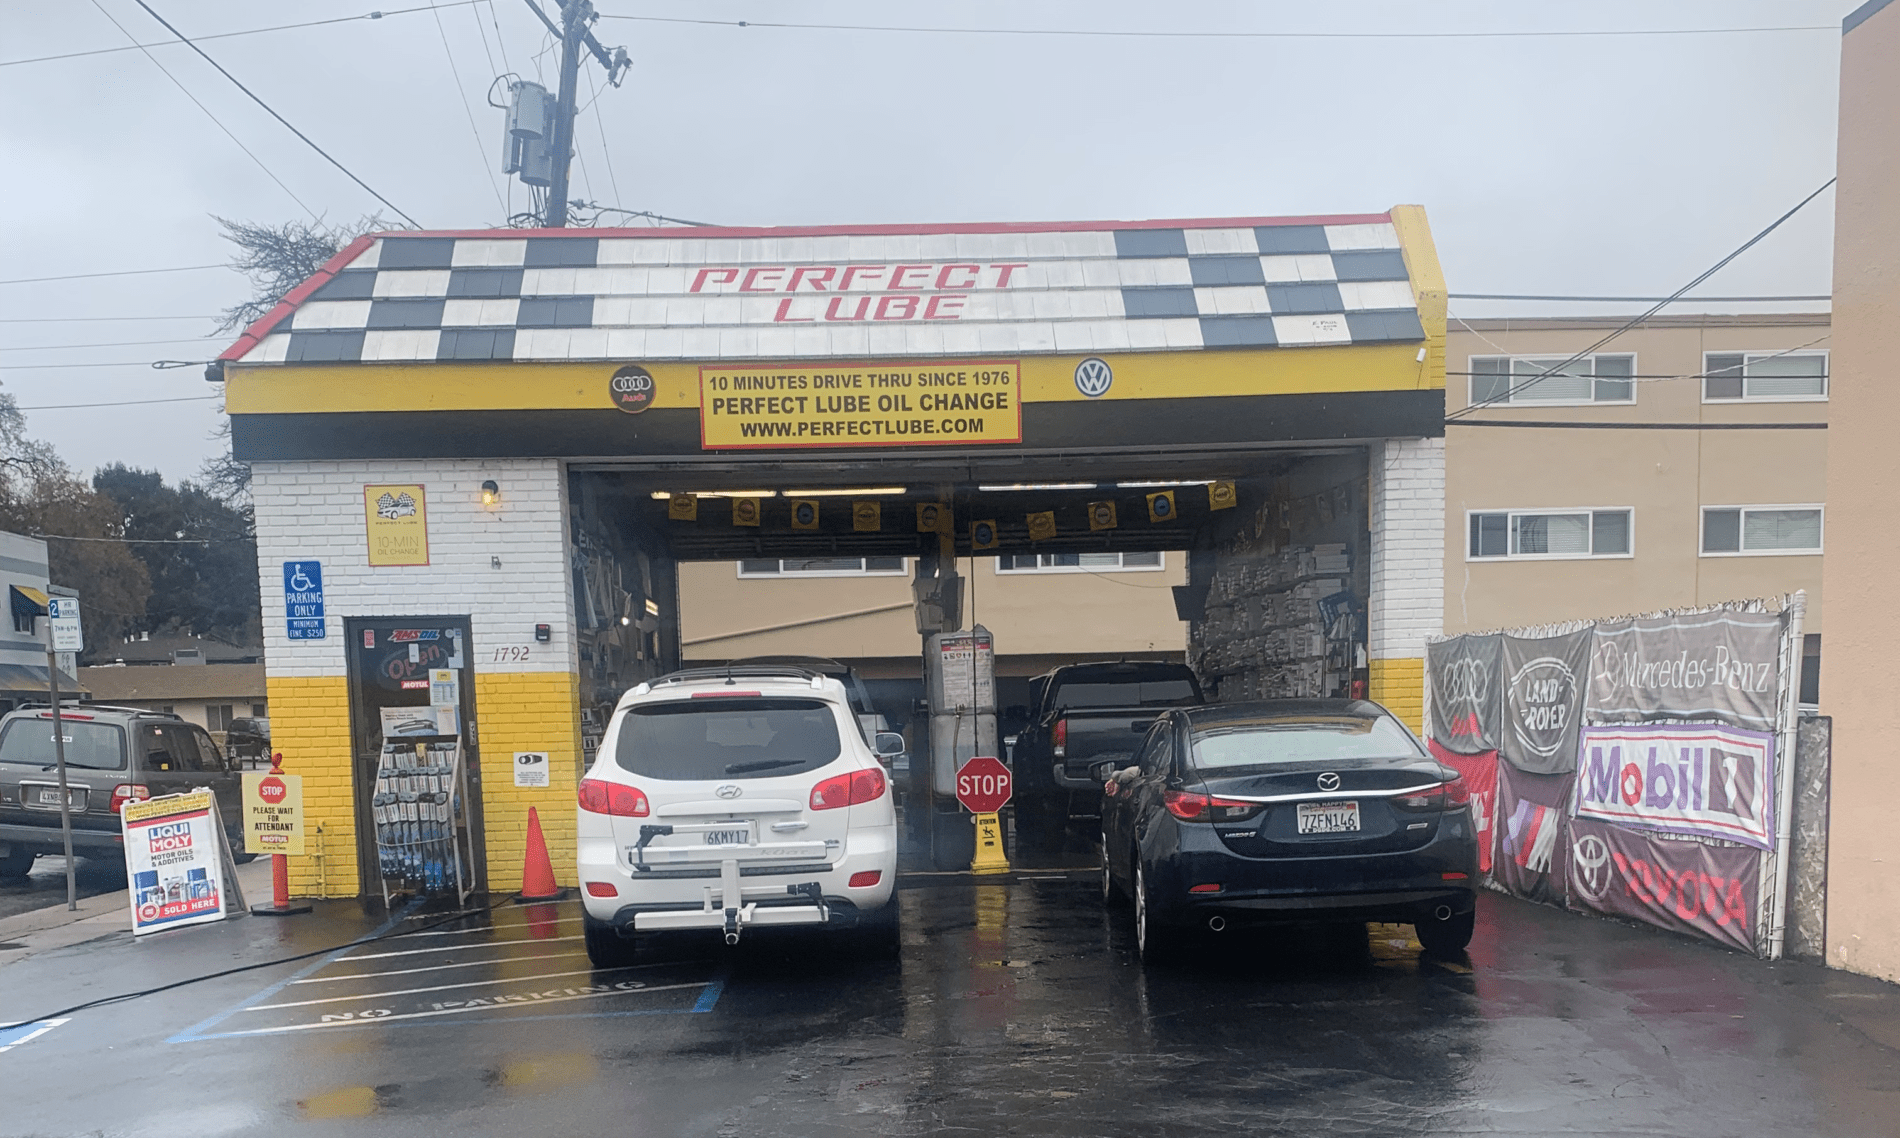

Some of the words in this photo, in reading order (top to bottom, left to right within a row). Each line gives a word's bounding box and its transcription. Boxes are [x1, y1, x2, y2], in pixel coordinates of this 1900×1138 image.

[689, 264, 1028, 292] PERFECT
[773, 294, 967, 322] LUBE
[710, 377, 728, 390] 10
[734, 375, 807, 390] MINUTES
[813, 374, 862, 388] DRIVE
[867, 373, 912, 387] THRU
[918, 371, 967, 386] SINCE
[972, 371, 1010, 385] 1976
[712, 396, 808, 415] PERFECT
[815, 395, 870, 413] LUBE
[877, 394, 912, 412] OIL
[919, 392, 1008, 411] CHANGE
[740, 418, 984, 437] WWW.PERFECTLUBE.COM
[378, 536, 419, 548] 10-MIN
[286, 592, 322, 604] PARKING
[50, 603, 58, 616] 2
[294, 605, 316, 616] ONLY
[293, 620, 319, 628] MINIMUM
[391, 630, 438, 640] AMSOIL
[494, 646, 530, 661] 1792
[1621, 644, 1770, 693] Mercedes-Benz
[959, 774, 1009, 796] STOP
[1587, 746, 1704, 811] Mobil
[1723, 756, 1739, 809] 1
[262, 786, 283, 796] STOP
[277, 807, 293, 815] WAIT
[254, 822, 294, 831] ATTENDANT
[1302, 813, 1355, 828] 7ZFN146
[149, 823, 190, 840] LIQUI
[707, 830, 749, 845] 6KMY17
[151, 835, 191, 853] MOLY
[151, 851, 176, 861] MOTOR
[177, 848, 194, 857] OILS
[158, 854, 195, 867] ADDITIVES
[164, 904, 187, 915] SOLD
[191, 898, 216, 910] HERE
[321, 1008, 392, 1022] NO
[432, 981, 646, 1010] PARKING
